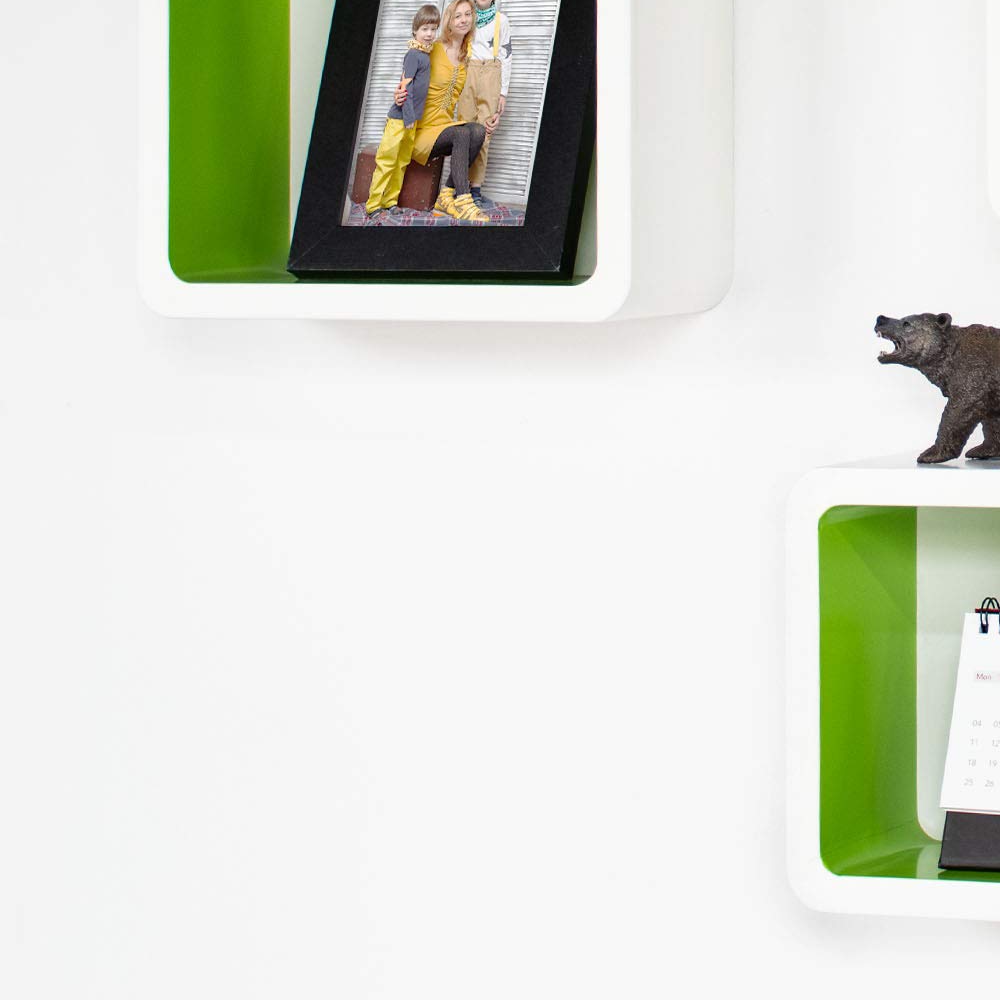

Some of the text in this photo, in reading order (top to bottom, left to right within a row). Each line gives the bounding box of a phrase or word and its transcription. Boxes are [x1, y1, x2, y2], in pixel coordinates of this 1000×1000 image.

[976, 672, 992, 681] Mon
[971, 719, 982, 728] 04
[969, 737, 979, 746] 11
[991, 739, 1000, 748] 12
[967, 758, 977, 768] 18
[988, 759, 998, 768] 19
[963, 777, 974, 787] 25
